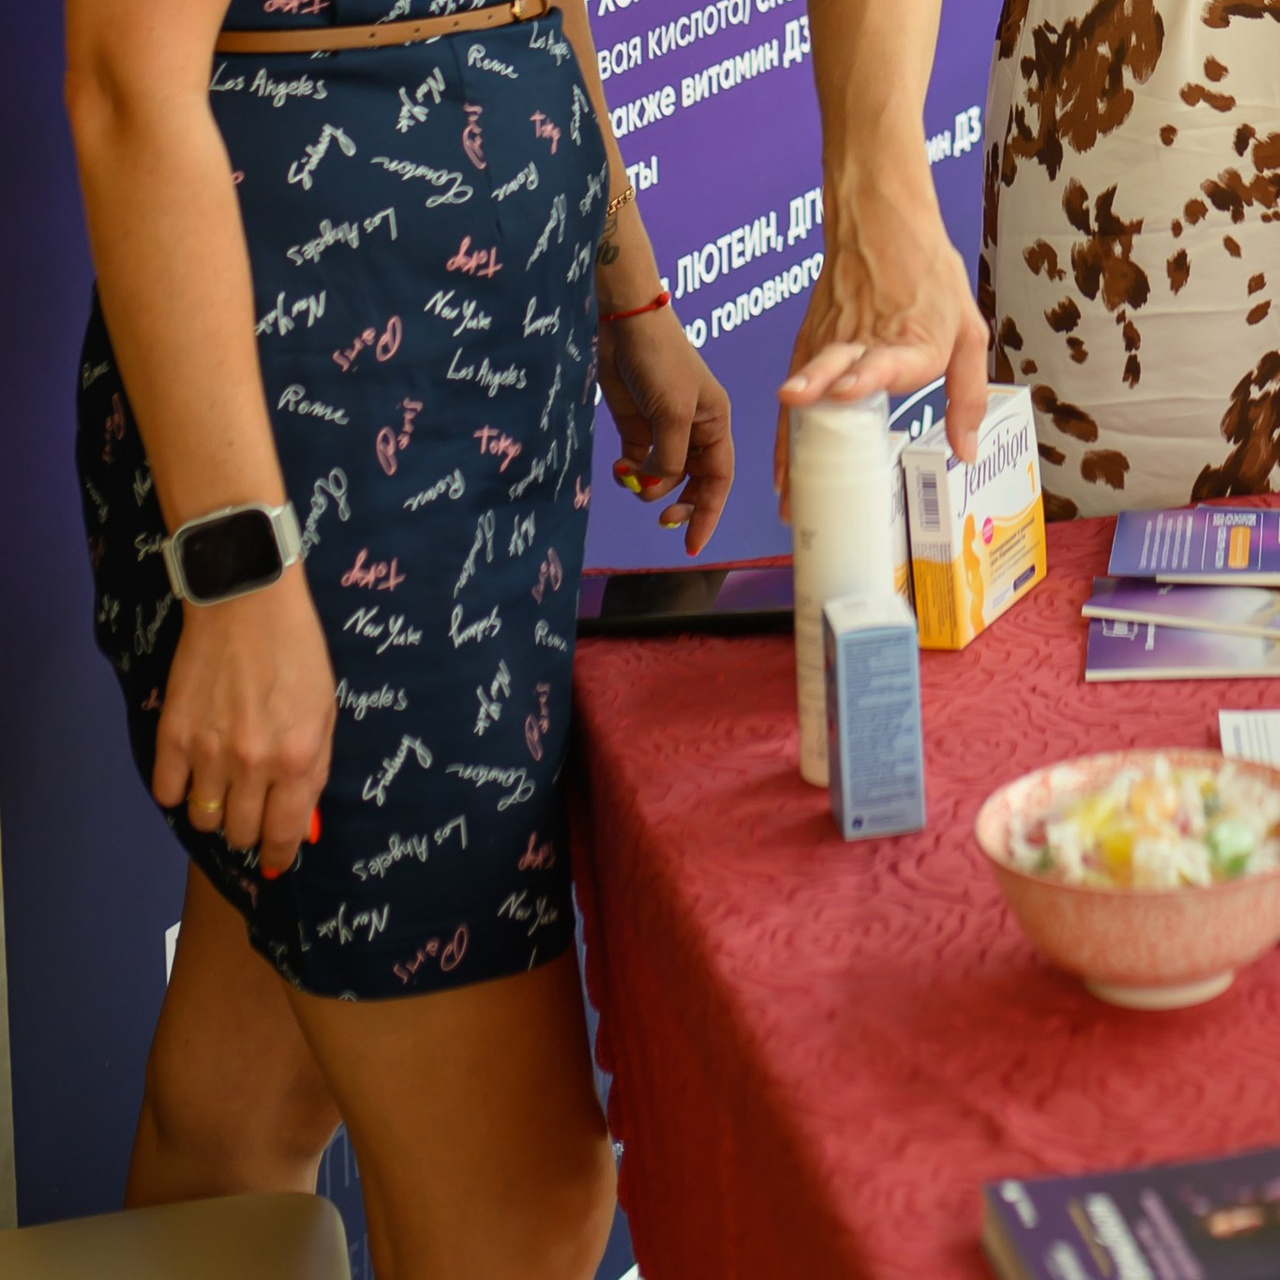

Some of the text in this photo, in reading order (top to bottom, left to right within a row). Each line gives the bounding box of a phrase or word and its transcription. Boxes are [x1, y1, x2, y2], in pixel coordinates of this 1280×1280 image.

[209, 61, 328, 108] Los Angeles
[467, 43, 519, 79] Rome
[681, 38, 779, 108] витамин
[675, 210, 784, 300] ЛЮТЕИН,
[711, 251, 825, 339] головного
[277, 383, 350, 425] Rome
[1026, 461, 1036, 496] 1
[333, 677, 408, 721] Angeles
[352, 815, 468, 881] Los Angeles
